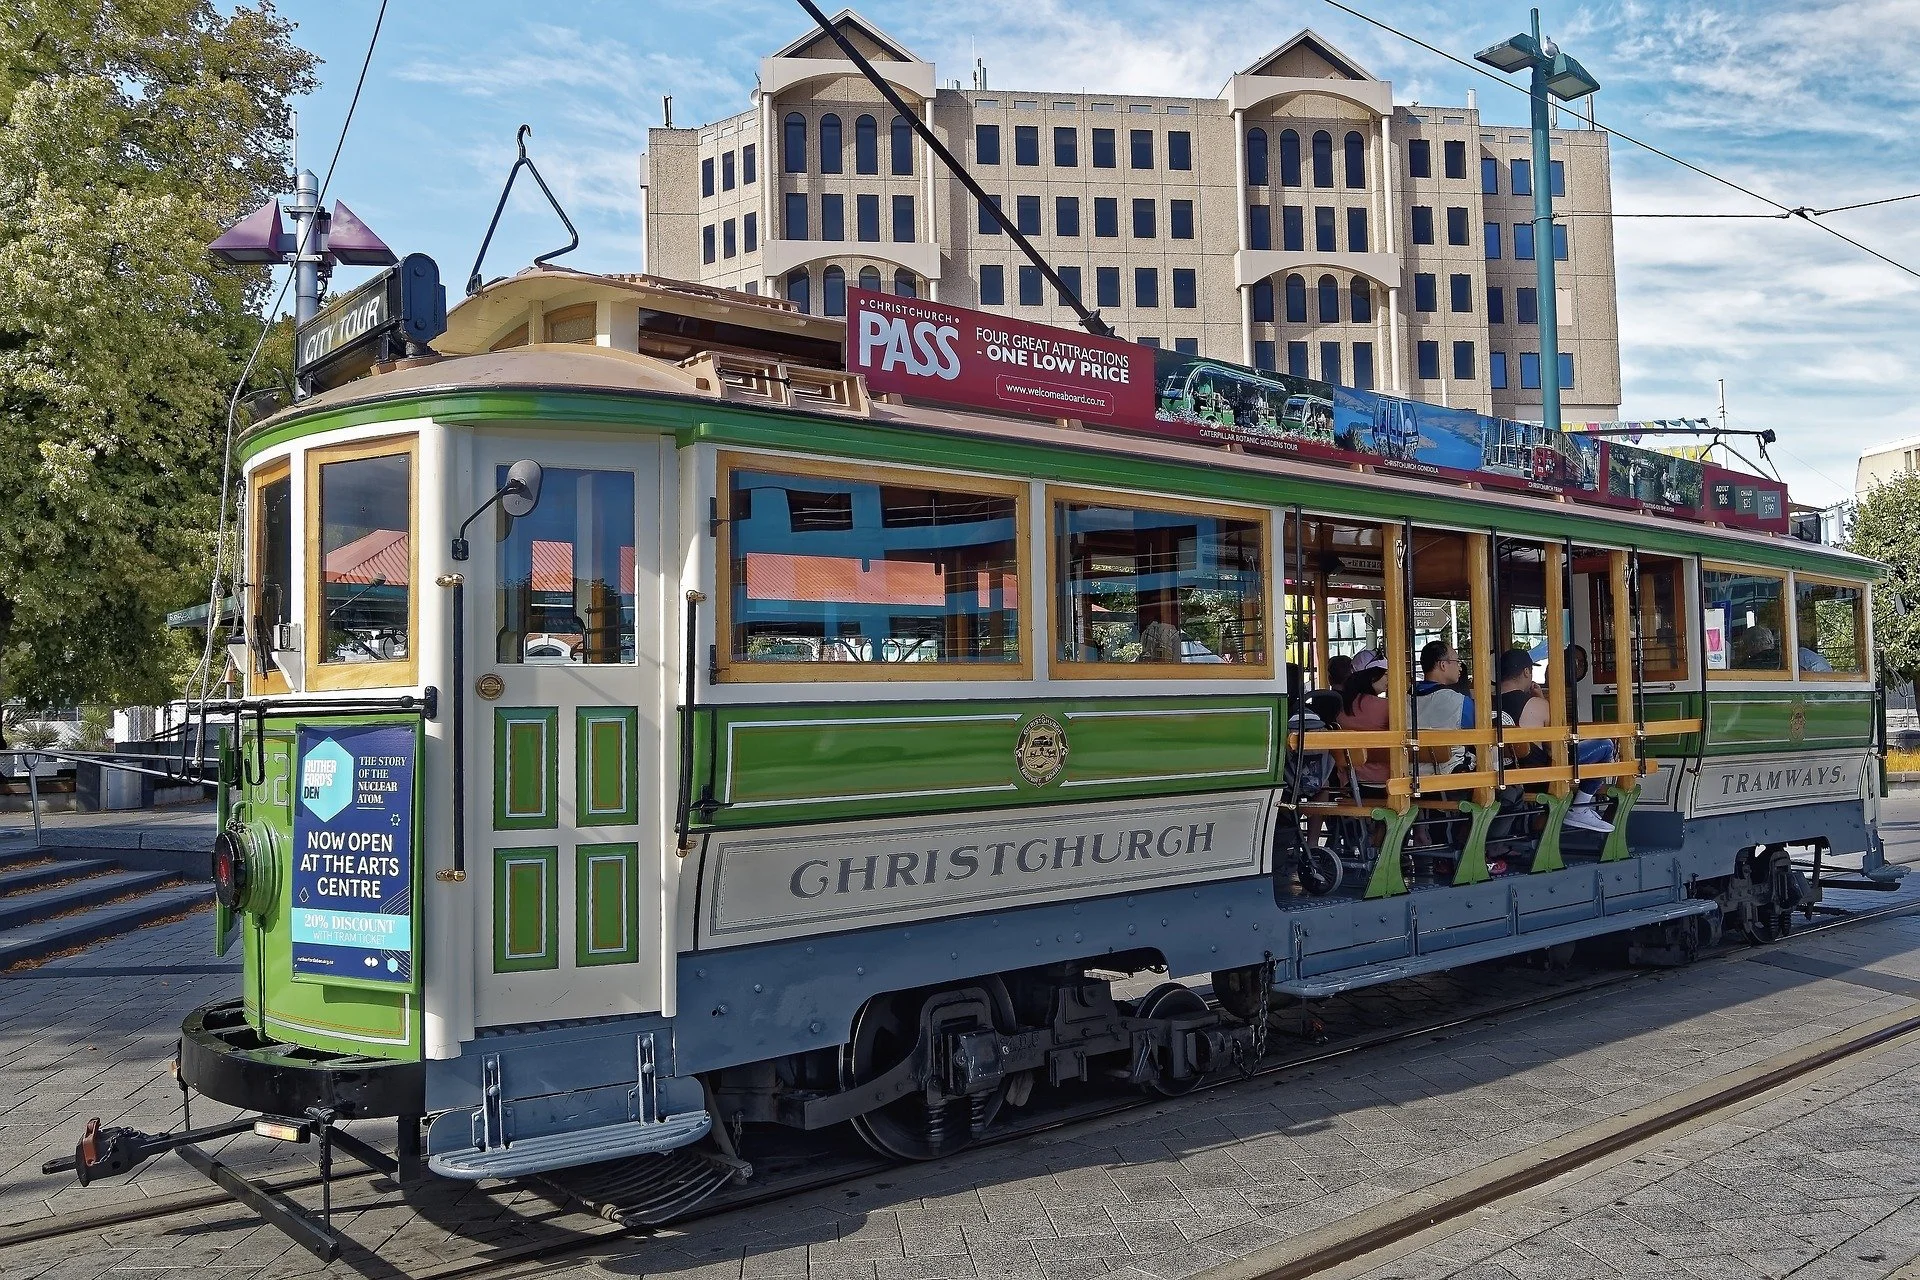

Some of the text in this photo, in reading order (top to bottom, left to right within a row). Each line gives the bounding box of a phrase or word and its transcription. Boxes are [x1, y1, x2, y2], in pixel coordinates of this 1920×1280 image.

[869, 300, 952, 323] CHRISTCHURCH
[305, 295, 380, 364] CITY TOUR
[859, 309, 961, 381] PASS
[976, 327, 1129, 368] FOUR GREAT ATTRACTIONS
[986, 344, 1028, 367] ONE
[1033, 353, 1076, 374] LOW
[1080, 361, 1130, 384] PRICE
[1005, 383, 1106, 407] www.welcomeaboard.co.nz
[1199, 429, 1299, 451] CATERPILLAR BOTANIC GARDENS TOUR
[1384, 459, 1439, 473] CHRISTCHURCH GONDOLA
[1715, 485, 1730, 493] ADULT
[1416, 619, 1430, 627] Park
[304, 759, 337, 773] RUTHER
[358, 756, 408, 766] THE STORY
[304, 772, 333, 787] FORD'S
[358, 769, 389, 779] OF THE
[1721, 765, 1847, 795] TRAMWAYS.
[303, 786, 320, 799] DEN
[357, 781, 398, 792] NUCLEAR
[307, 831, 393, 852] NOW OPEN
[300, 853, 399, 876] AT THE ARTS
[788, 821, 1218, 900] CHRISTCHURCH
[317, 876, 382, 899] CENTRE
[304, 913, 395, 934] 20% DISCOUNT
[312, 930, 386, 945] WITH TRAM TICKET
